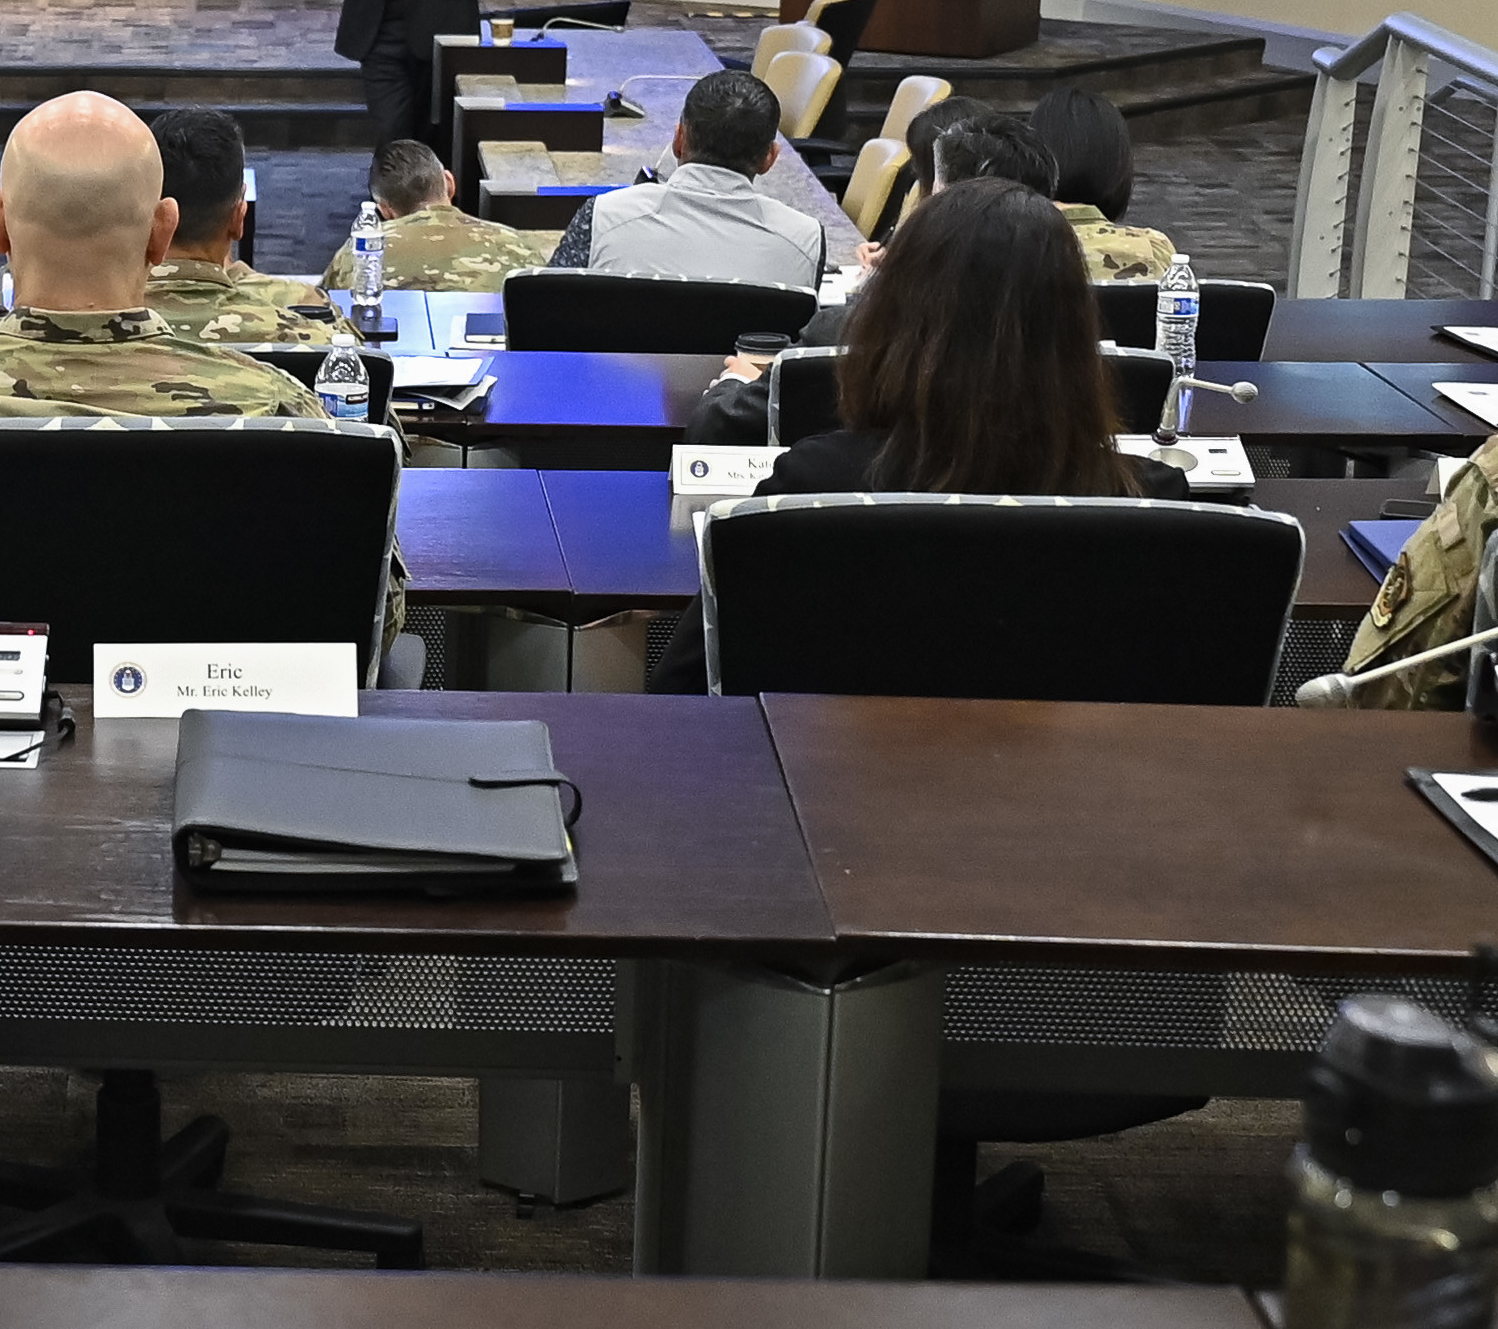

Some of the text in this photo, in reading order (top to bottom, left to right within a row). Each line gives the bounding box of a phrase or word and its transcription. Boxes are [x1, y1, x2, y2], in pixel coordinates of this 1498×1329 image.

[207, 663, 243, 680] Eric
[176, 684, 273, 700] Mr. Eric Kelley
